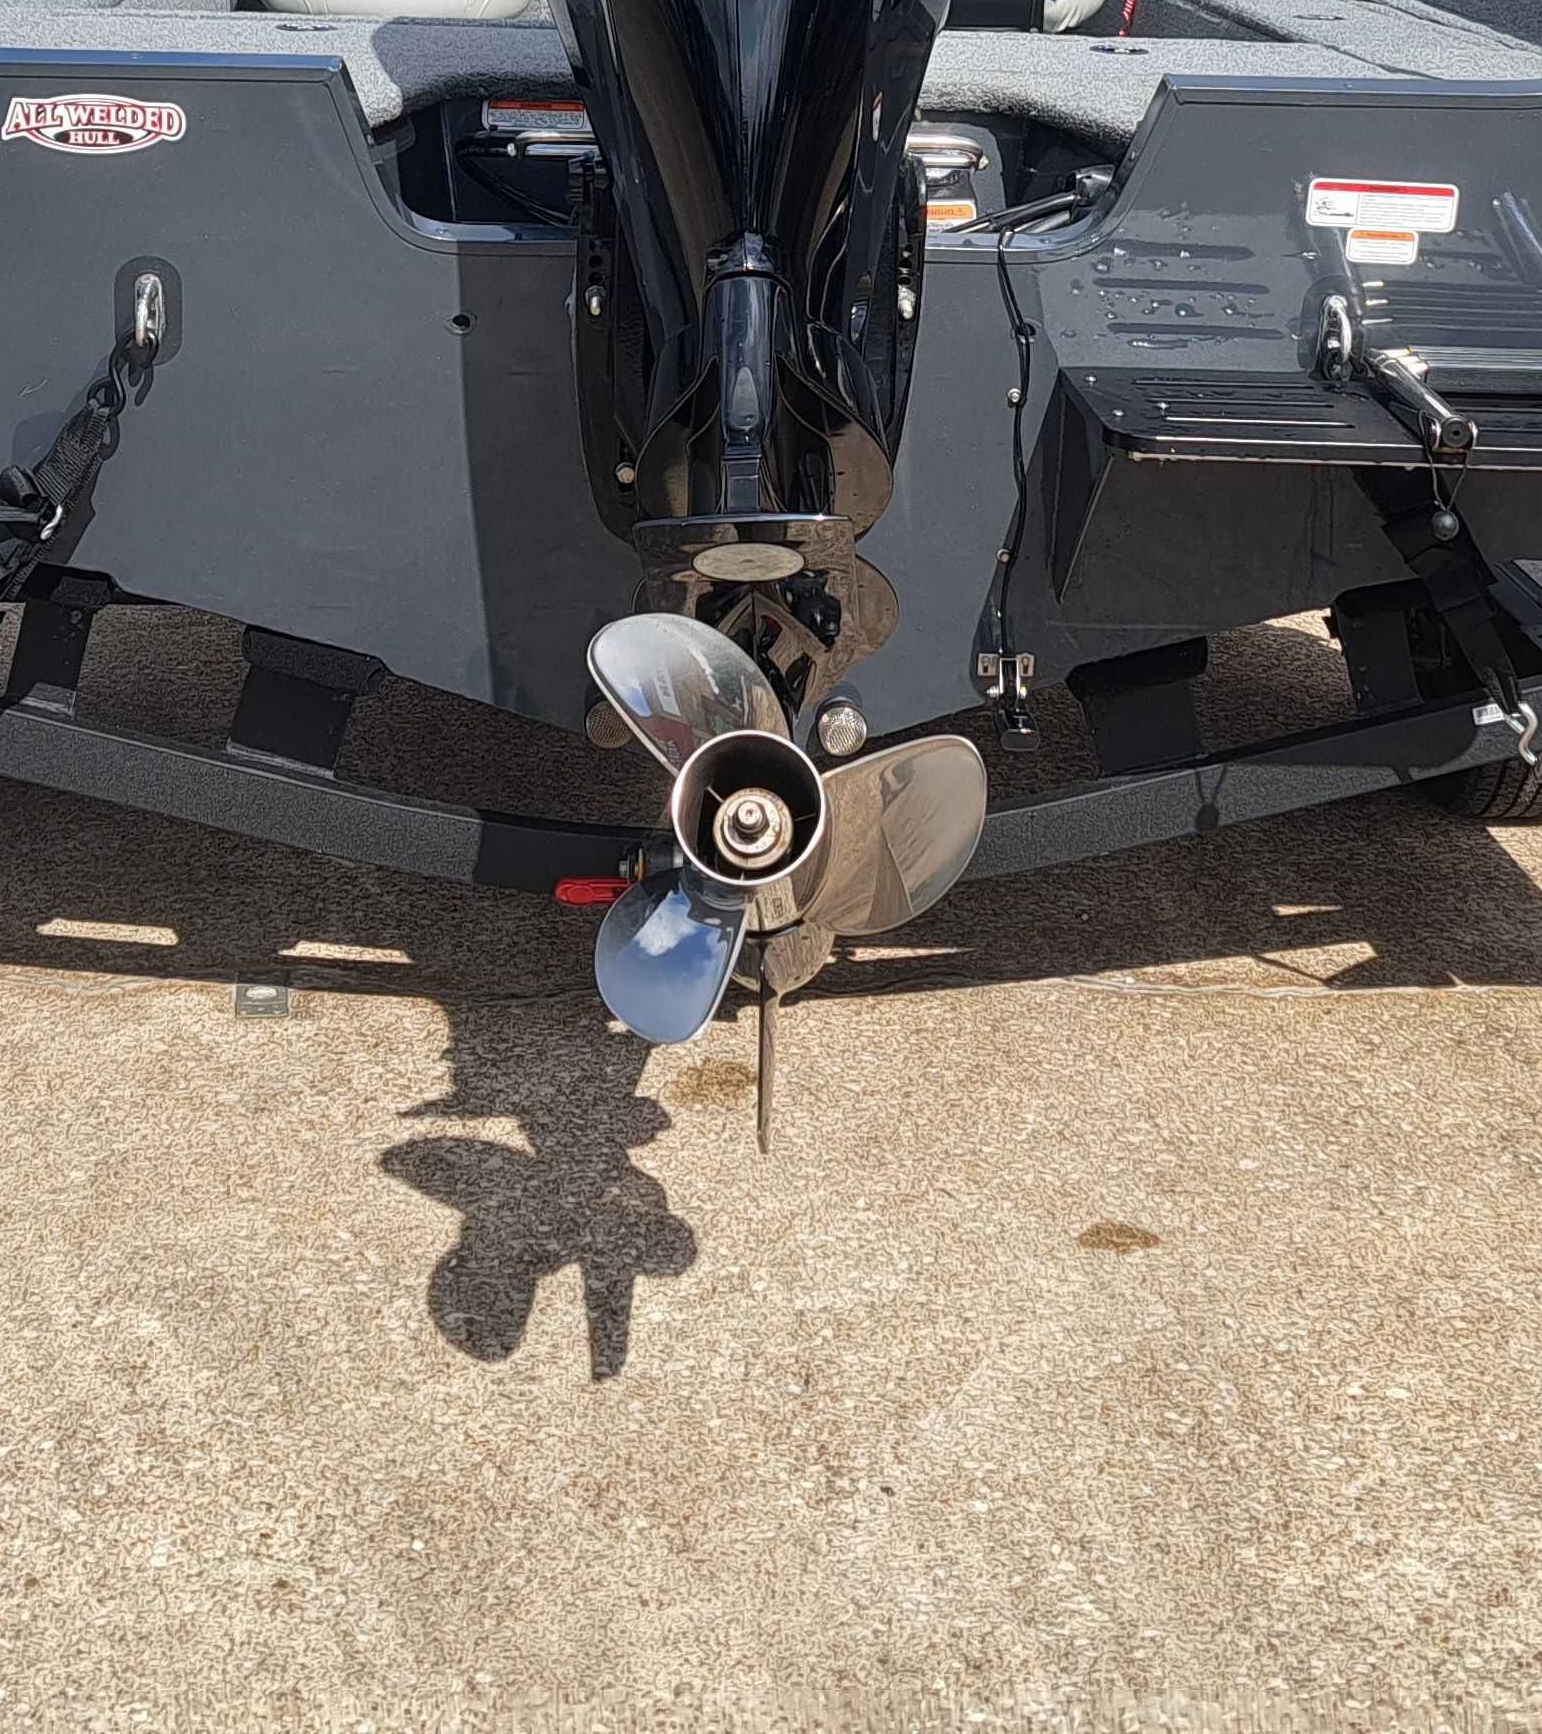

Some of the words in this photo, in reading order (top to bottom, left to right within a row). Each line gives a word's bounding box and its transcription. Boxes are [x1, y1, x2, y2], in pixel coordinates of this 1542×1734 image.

[6, 101, 62, 134] ALL
[64, 104, 181, 136] WELDED
[68, 130, 120, 145] HULL
